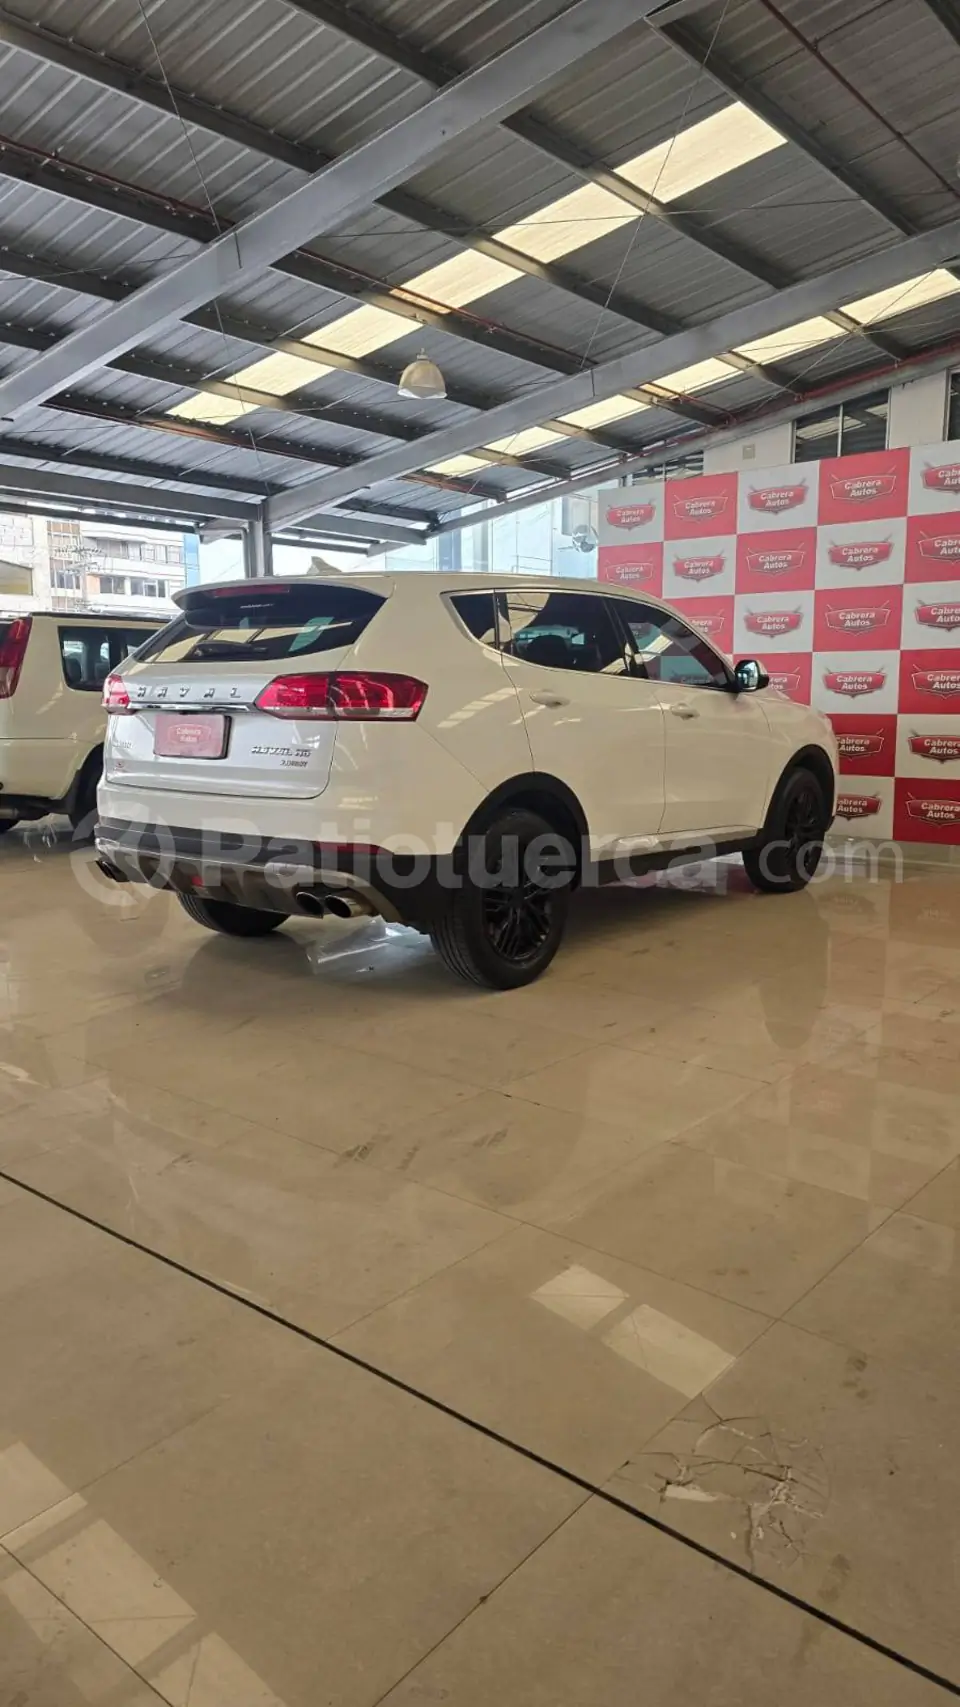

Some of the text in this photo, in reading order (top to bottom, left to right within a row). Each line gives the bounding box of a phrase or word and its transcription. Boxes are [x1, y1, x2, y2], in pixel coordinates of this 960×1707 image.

[938, 468, 960, 478] Cabr
[844, 479, 882, 490] Cabrera
[944, 477, 960, 486] Aut
[761, 491, 794, 500] Cabrera
[850, 488, 877, 498] Autos
[685, 500, 716, 509] Cabrera
[765, 499, 789, 507] Autos
[616, 508, 645, 516] Cabrera
[689, 508, 712, 516] Autos
[842, 547, 878, 556] Cabrera
[759, 554, 792, 562] Cabrera
[847, 554, 874, 563] Autos
[684, 560, 714, 568] Cabrera
[763, 561, 788, 570] Autos
[615, 566, 644, 574] Cabrera
[688, 567, 710, 575] Autos
[838, 611, 876, 620] Cabrera
[931, 607, 960, 616] Cabre
[757, 615, 789, 623] Cabrera
[844, 619, 871, 627] Autos
[936, 615, 960, 623] Auto
[836, 674, 872, 683] Cabrera
[927, 673, 960, 682] Cabrer
[841, 682, 868, 690] Autos
[137, 686, 241, 699] HAVAL
[839, 744, 865, 752] Autos
[929, 746, 959, 755] Autos
[837, 805, 863, 813] Autos
[921, 802, 960, 812] Cabrera
[926, 810, 956, 819] Autos
